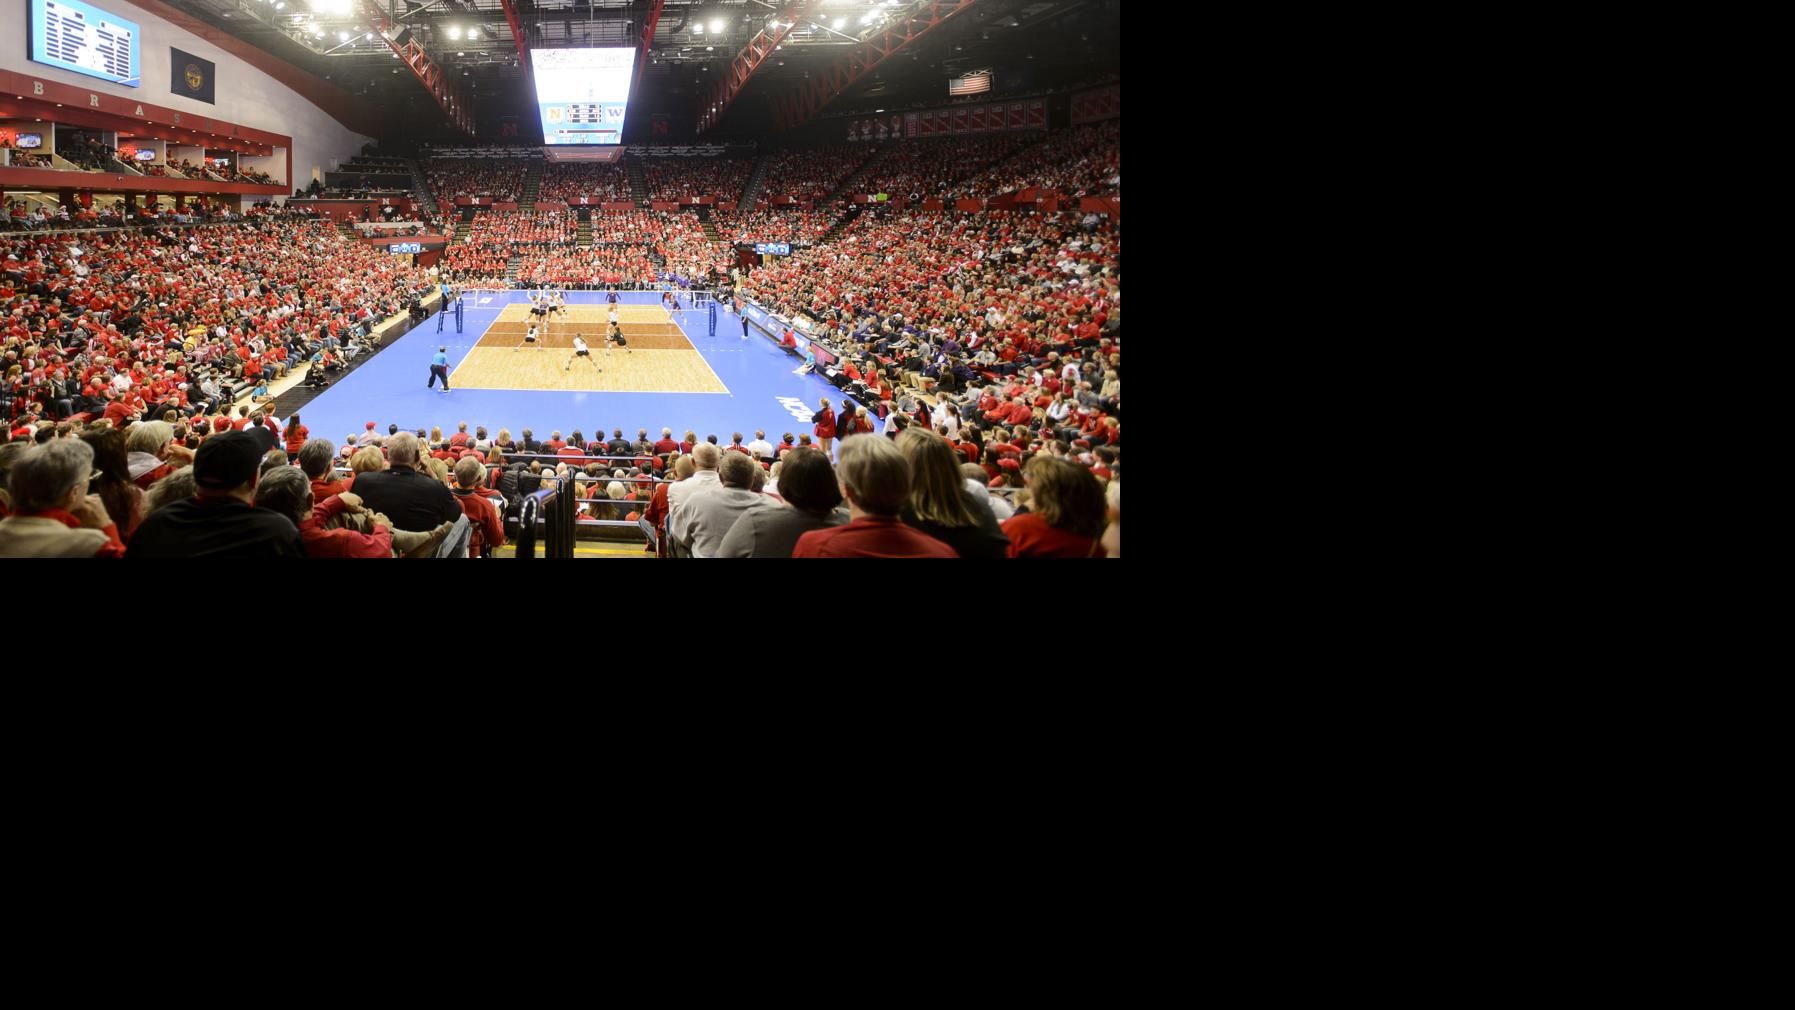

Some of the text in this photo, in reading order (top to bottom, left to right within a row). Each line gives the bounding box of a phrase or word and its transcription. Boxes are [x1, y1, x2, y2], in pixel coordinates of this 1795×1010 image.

[549, 108, 561, 119] N
[607, 108, 623, 117] W
[691, 196, 700, 204] N
